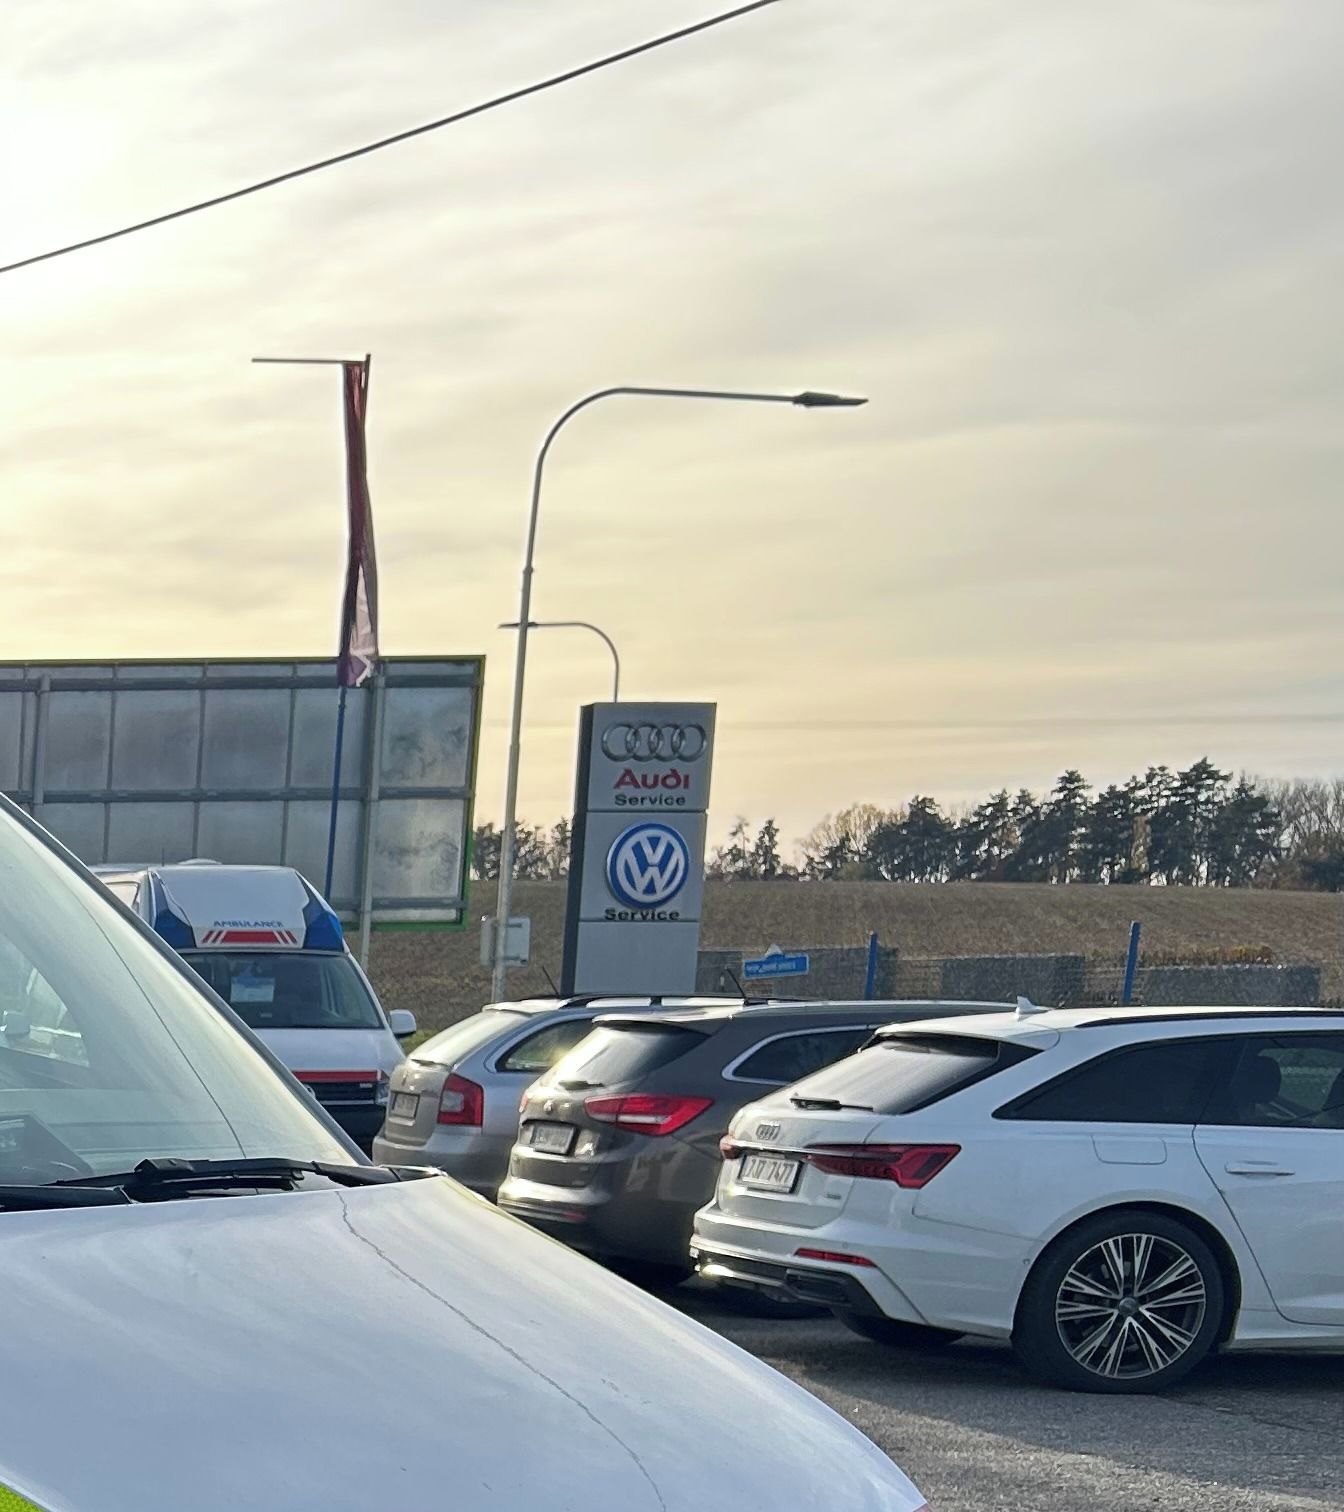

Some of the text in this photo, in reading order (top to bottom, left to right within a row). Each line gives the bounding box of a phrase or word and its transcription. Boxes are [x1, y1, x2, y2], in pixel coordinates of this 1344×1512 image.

[613, 768, 690, 790] Audi
[614, 794, 686, 807] Service
[604, 908, 680, 921] Service
